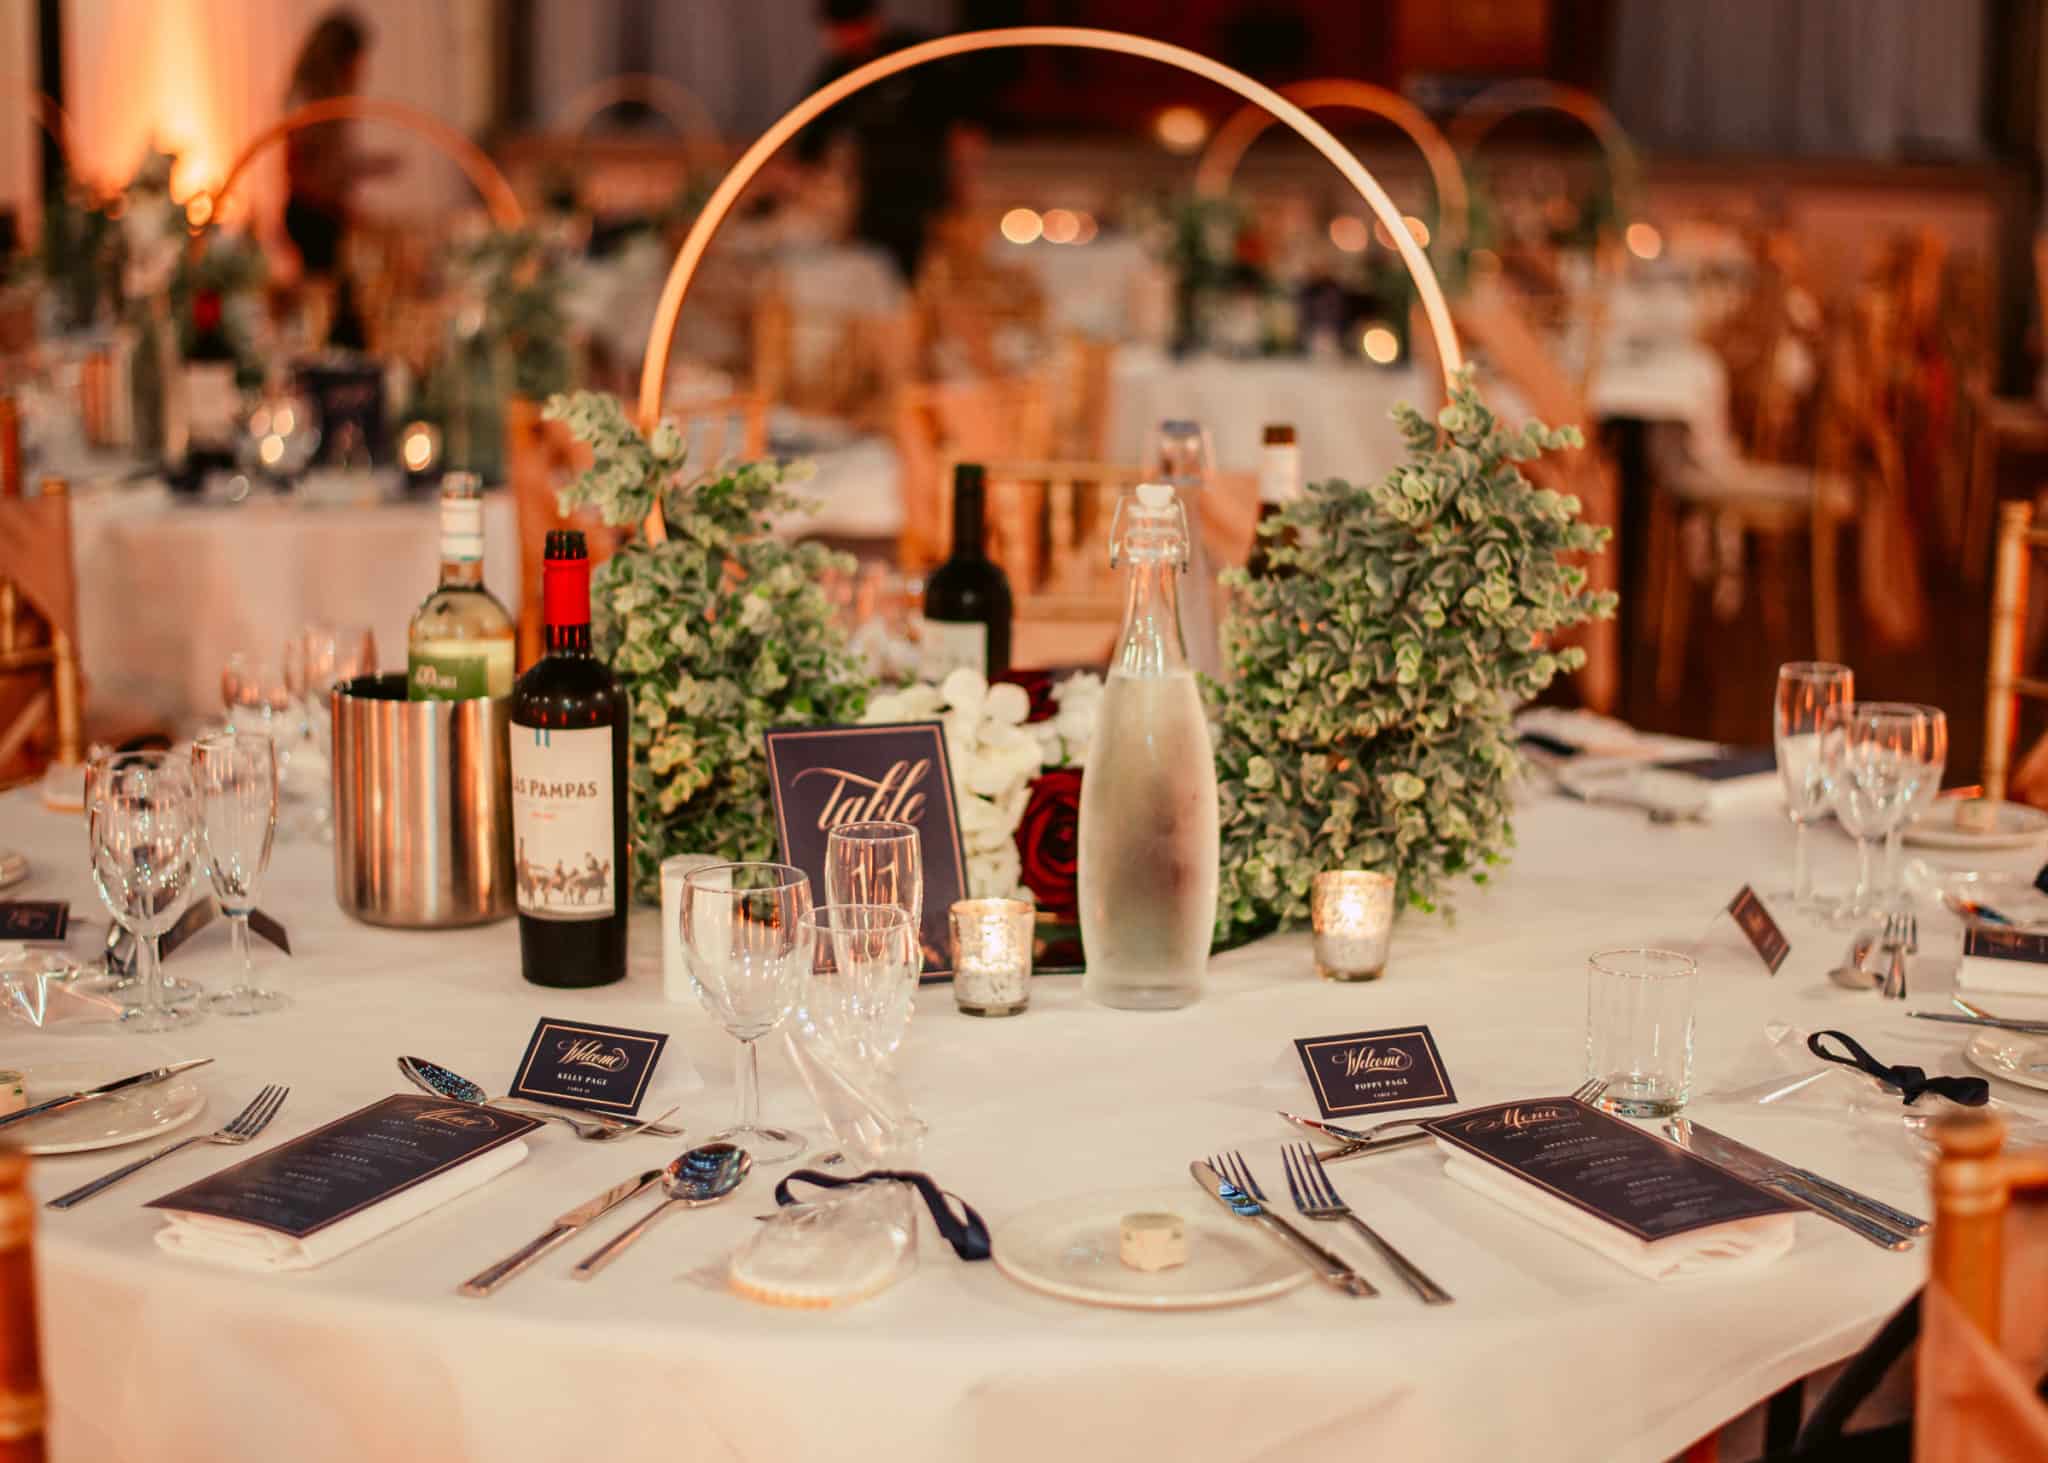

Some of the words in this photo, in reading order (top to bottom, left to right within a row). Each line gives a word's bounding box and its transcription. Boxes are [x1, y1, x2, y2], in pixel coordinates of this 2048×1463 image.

[529, 779, 598, 798] PAMPAS
[792, 758, 931, 830] Table
[557, 1038, 629, 1073] Welcome
[1332, 1046, 1413, 1077] Welcome
